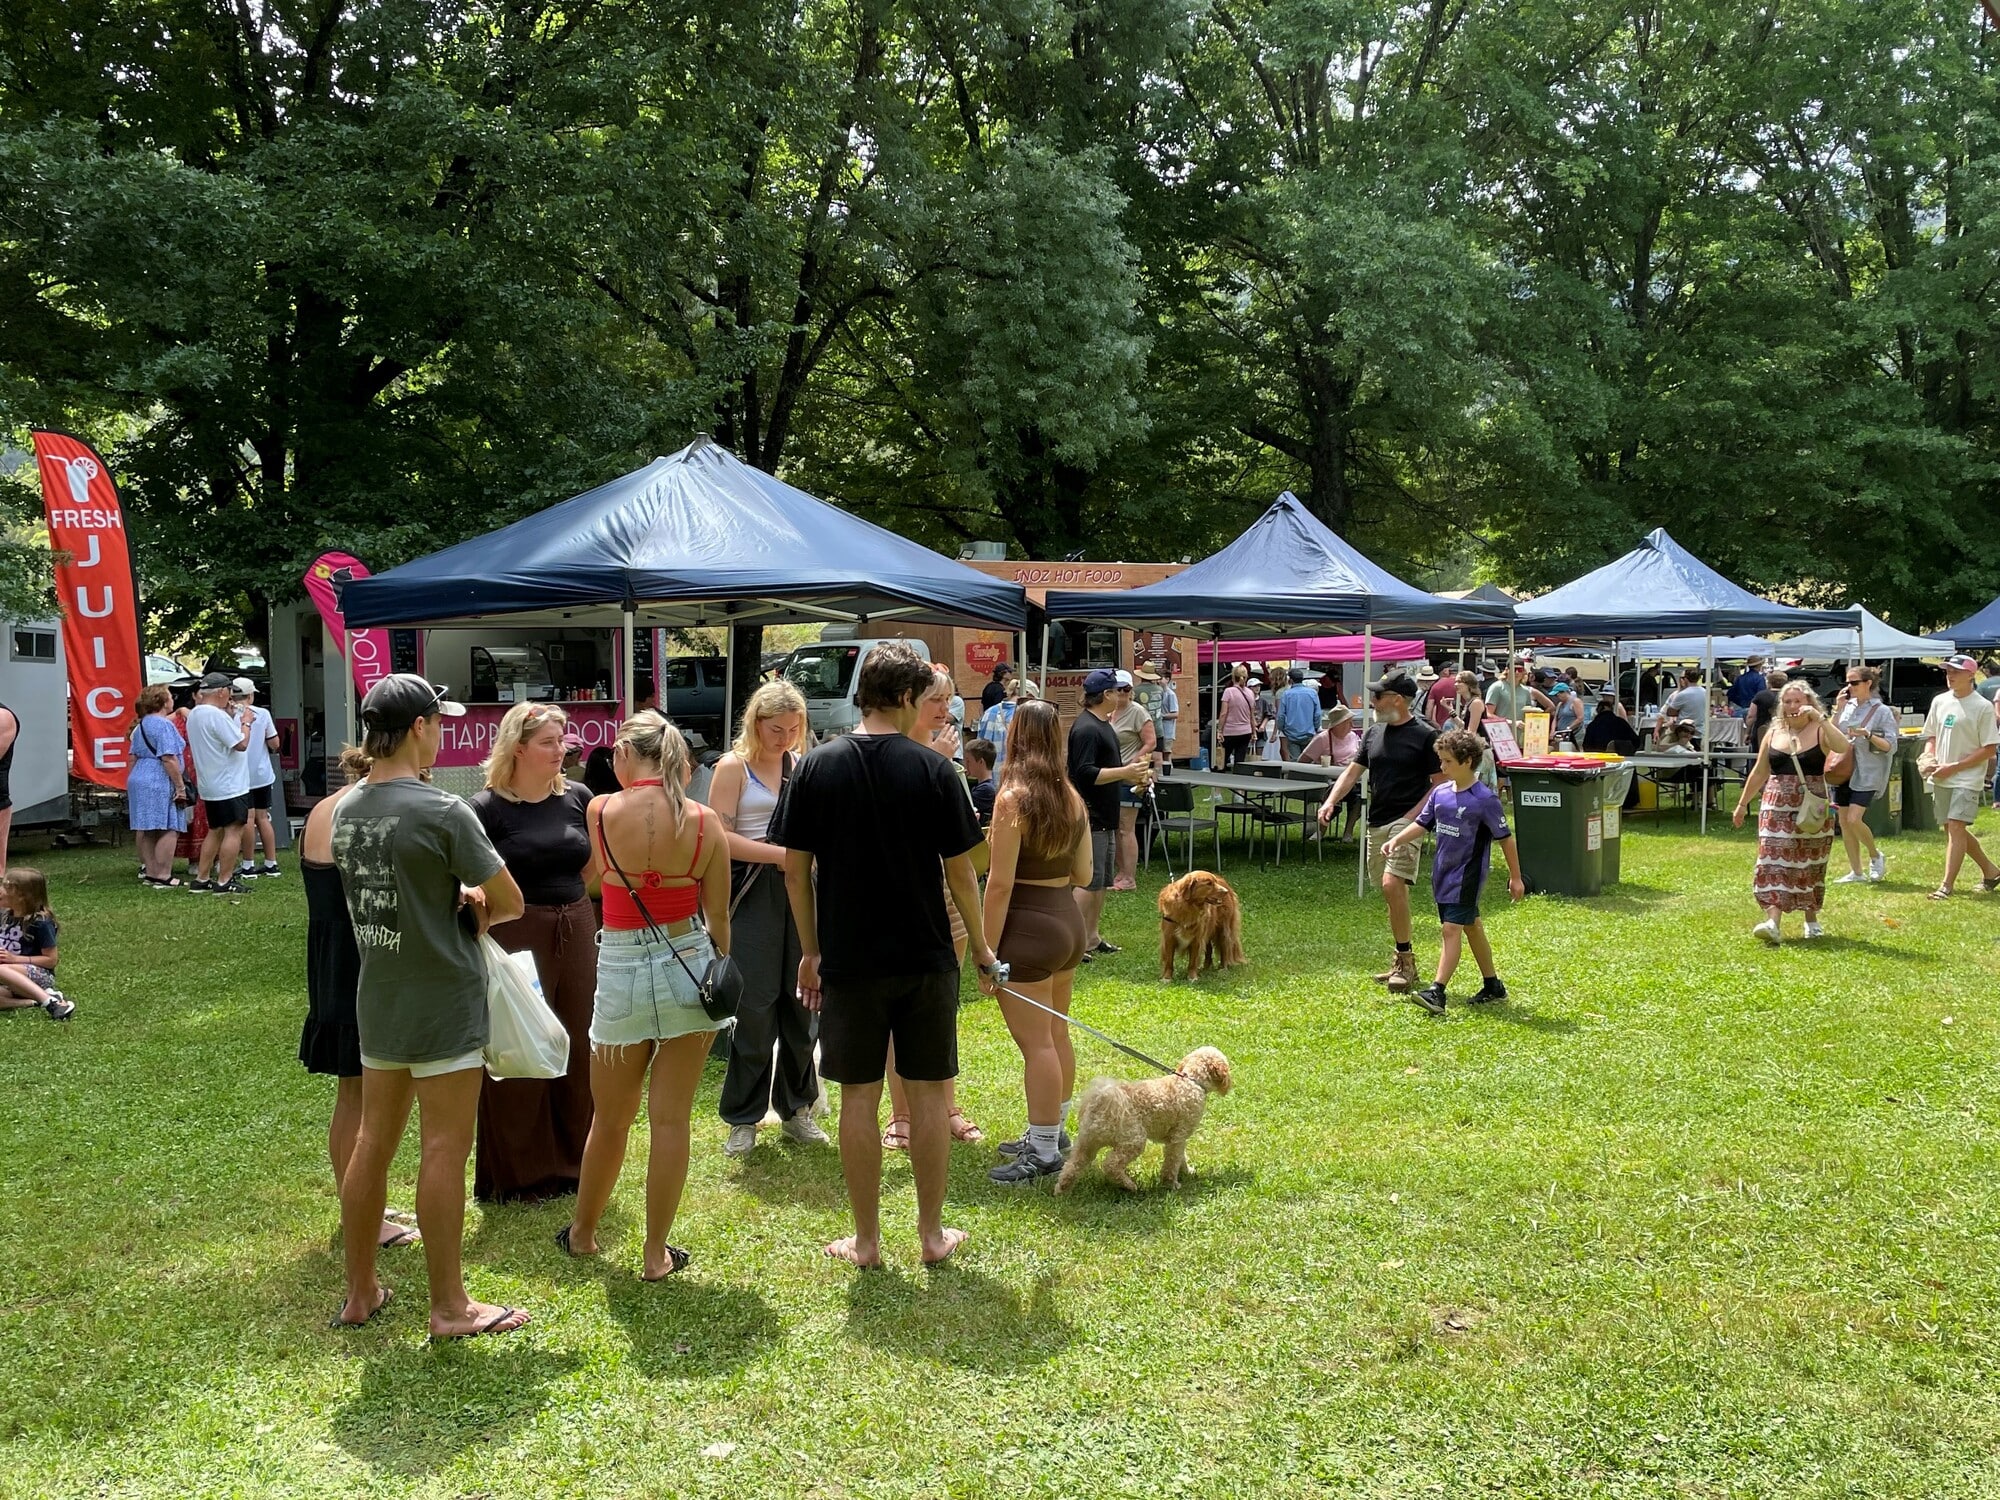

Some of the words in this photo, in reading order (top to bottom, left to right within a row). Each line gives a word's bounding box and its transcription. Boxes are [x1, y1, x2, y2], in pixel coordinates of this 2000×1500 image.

[51, 509, 121, 529] FRESH
[1013, 568, 1051, 584] INOZ
[1054, 569, 1083, 584] HOT
[1084, 569, 1123, 584] FOOD
[77, 534, 128, 769] JUICE
[1523, 794, 1559, 804] EVENTS
